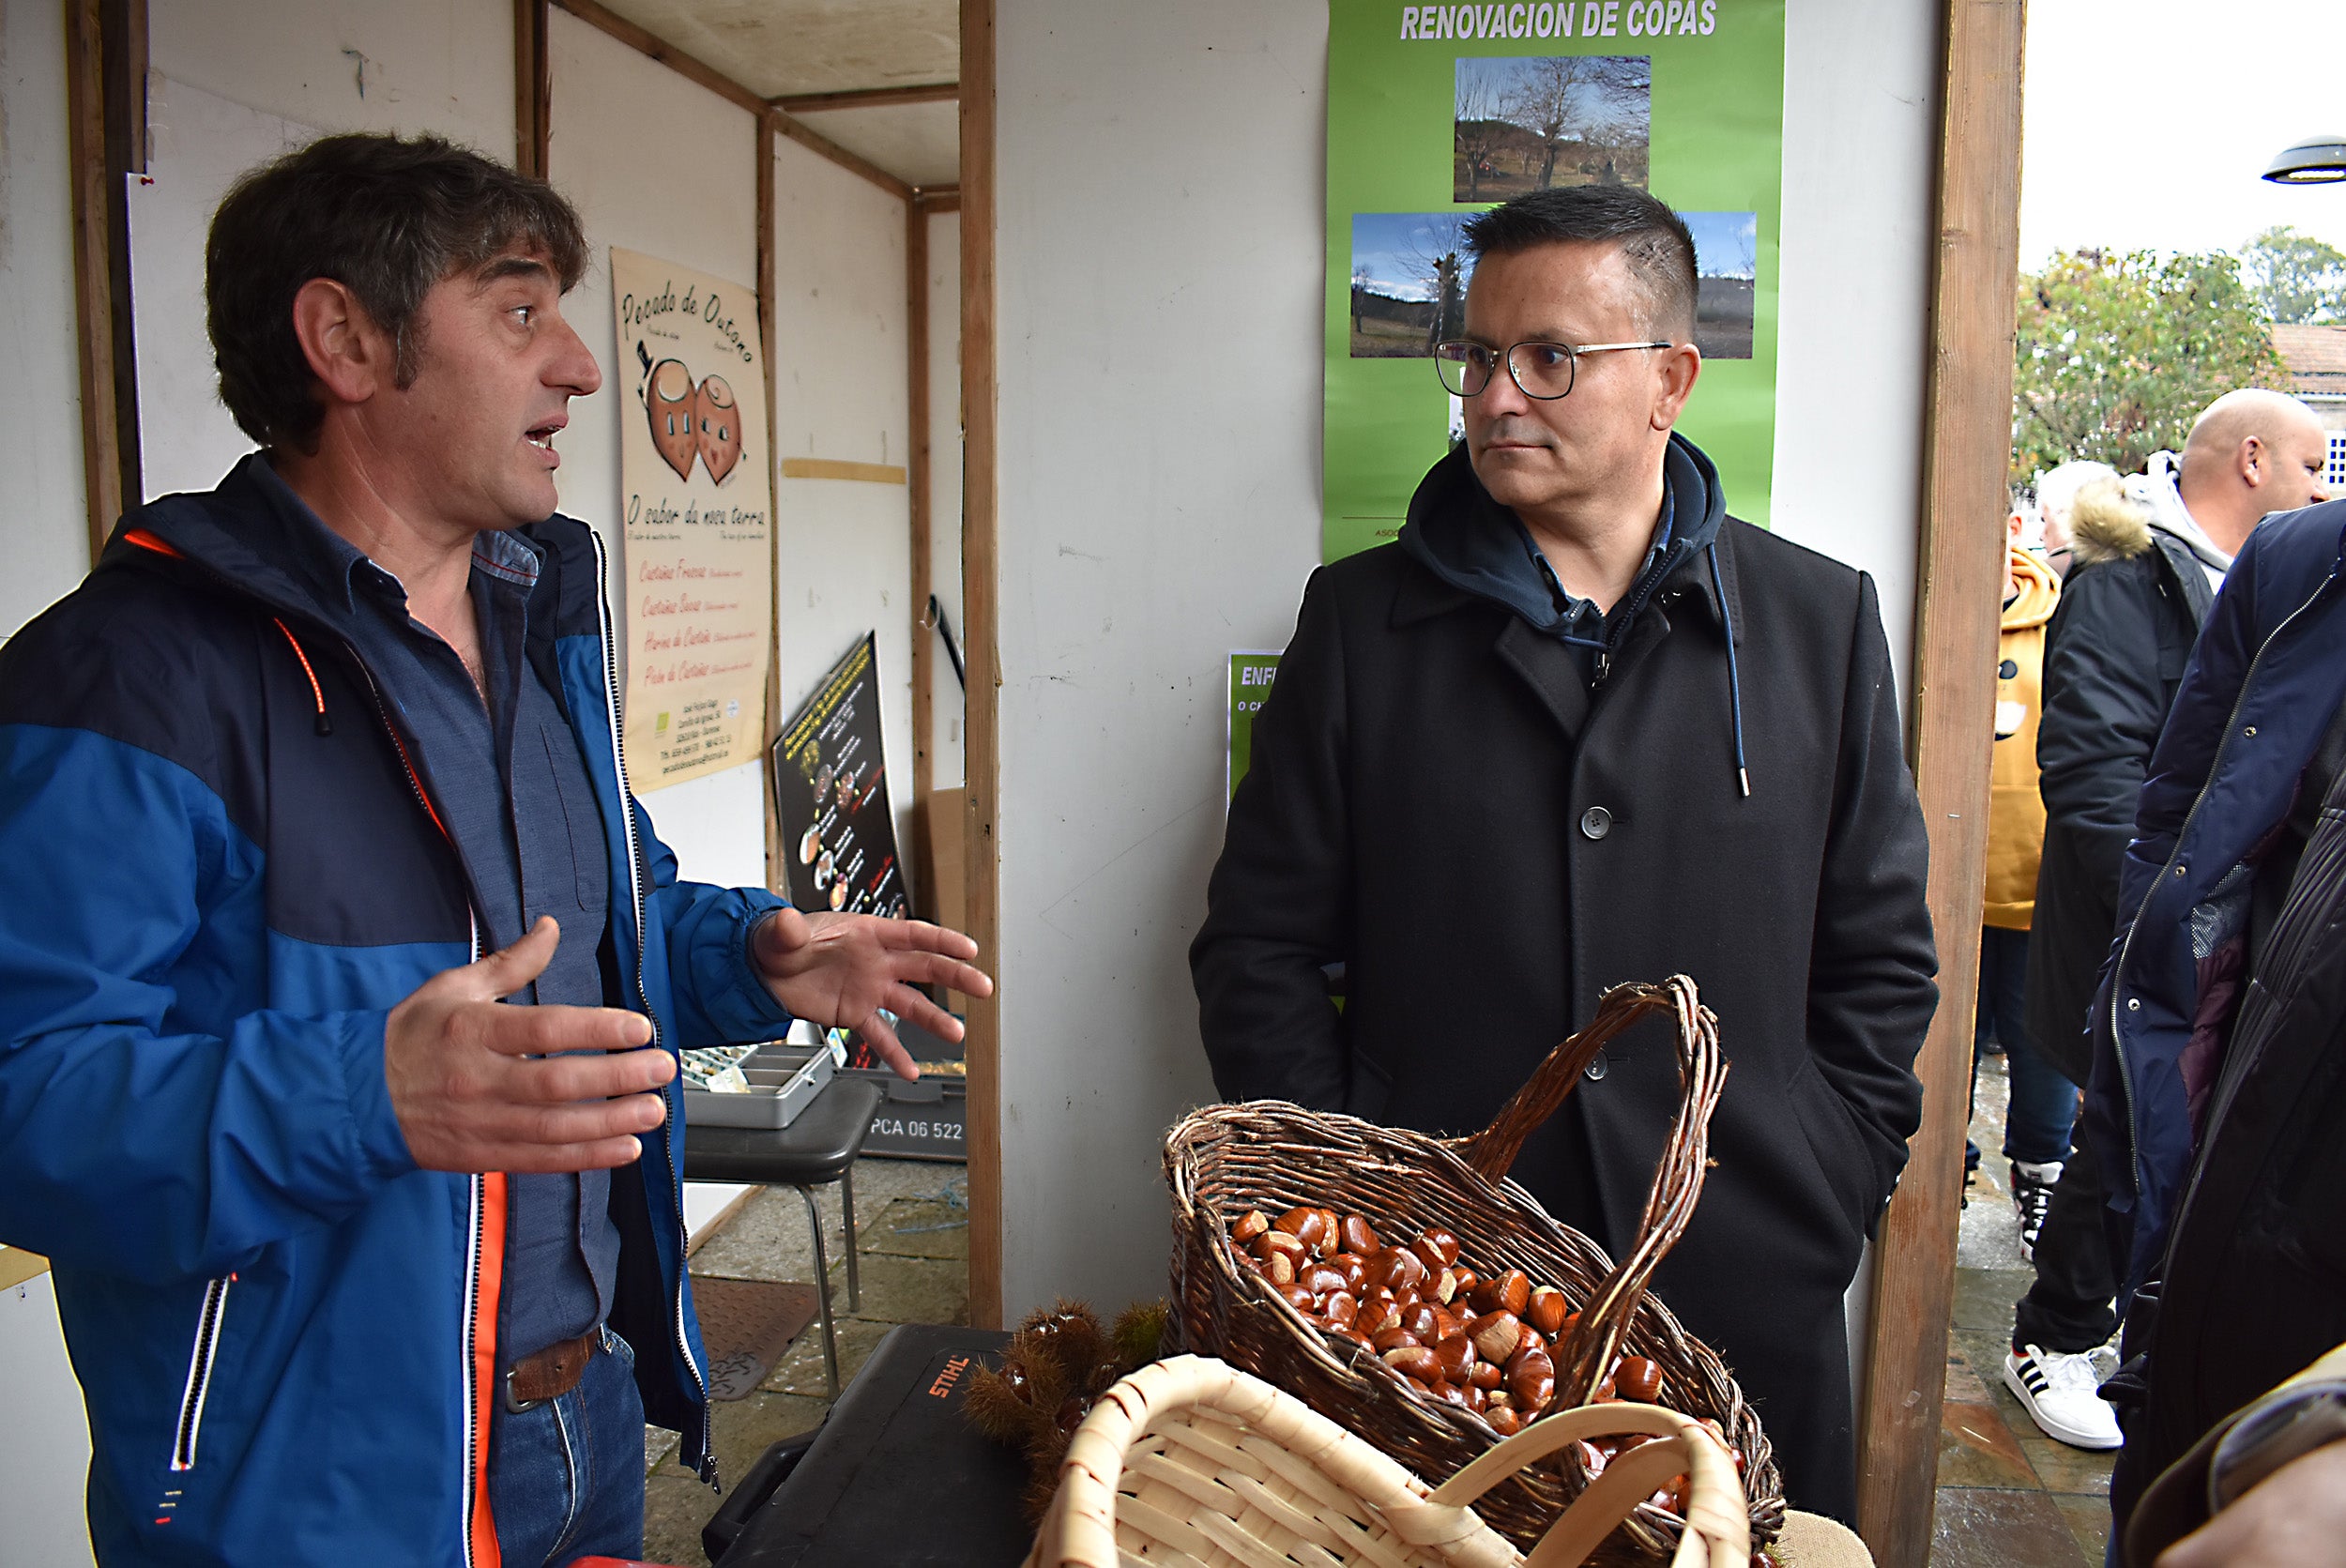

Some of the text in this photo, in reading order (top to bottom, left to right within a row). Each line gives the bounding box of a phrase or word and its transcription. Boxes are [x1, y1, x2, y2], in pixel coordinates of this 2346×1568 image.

[1401, 0, 1717, 39] RENOVACION DE COPAS
[681, 284, 698, 315] de
[704, 293, 754, 363] Outono
[627, 494, 641, 525] O
[645, 496, 678, 525] sabor
[684, 498, 699, 525] da
[731, 504, 766, 526] terra
[1242, 666, 1277, 685] ENF
[1238, 701, 1246, 711] O
[871, 1118, 963, 1140] PCA 06 522
[928, 1357, 970, 1399] STIHL
